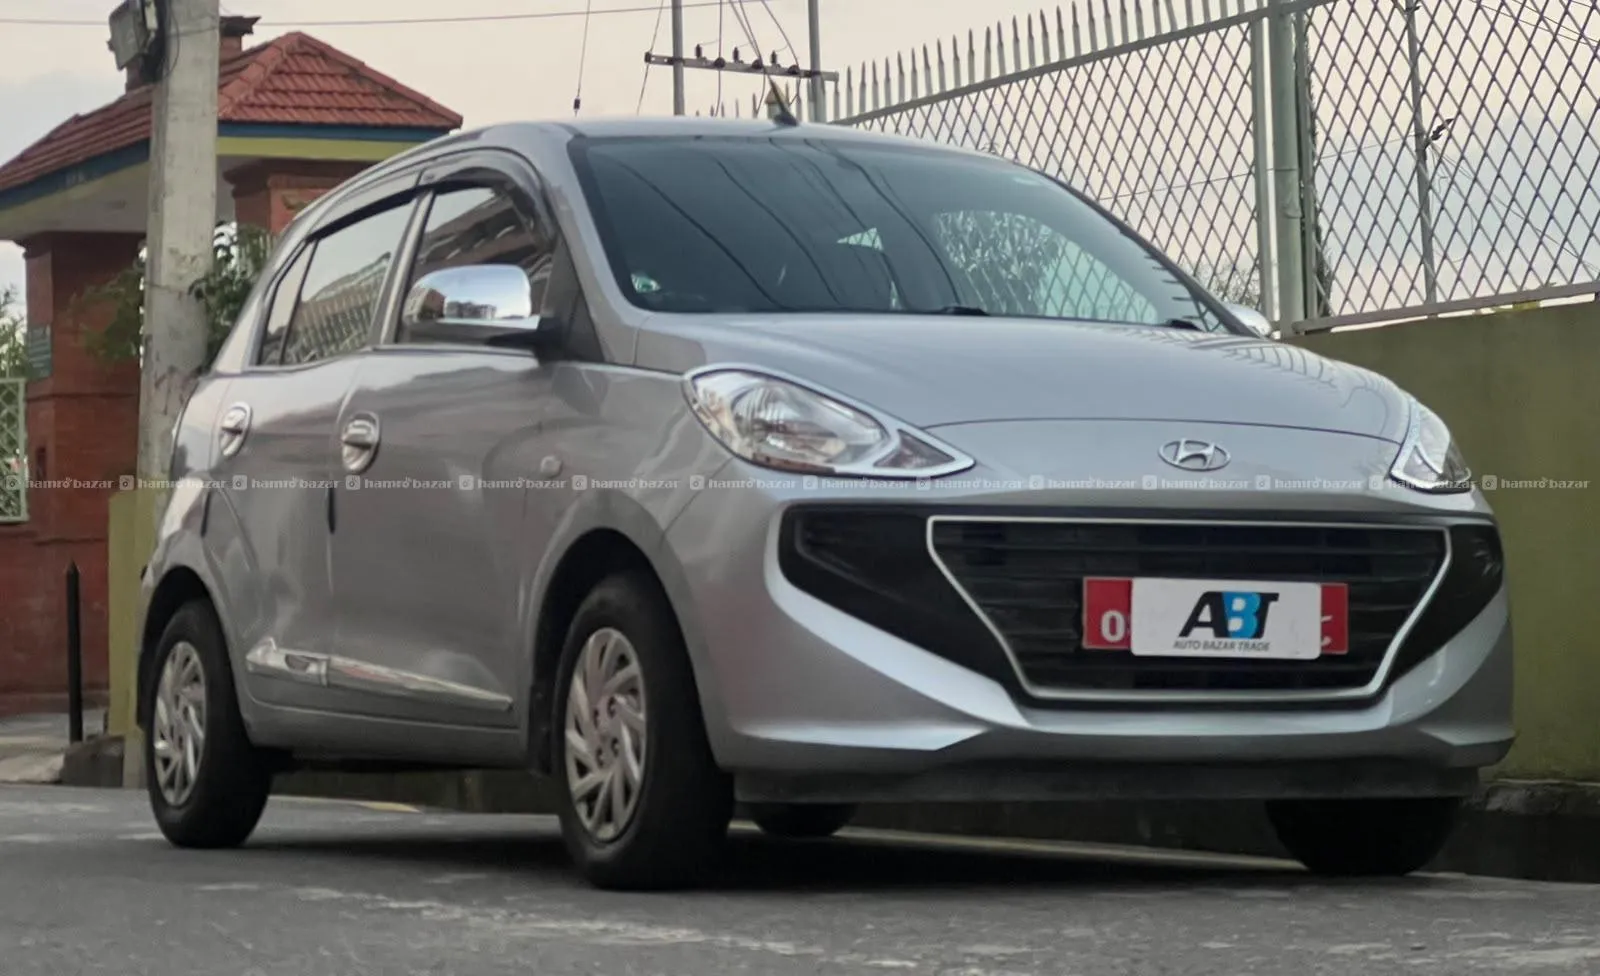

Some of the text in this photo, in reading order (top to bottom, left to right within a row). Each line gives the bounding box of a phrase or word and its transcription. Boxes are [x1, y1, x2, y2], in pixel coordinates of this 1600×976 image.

[1178, 591, 1279, 639] ABT
[1173, 639, 1200, 650] AUTO
[1202, 640, 1236, 651] BAZAR
